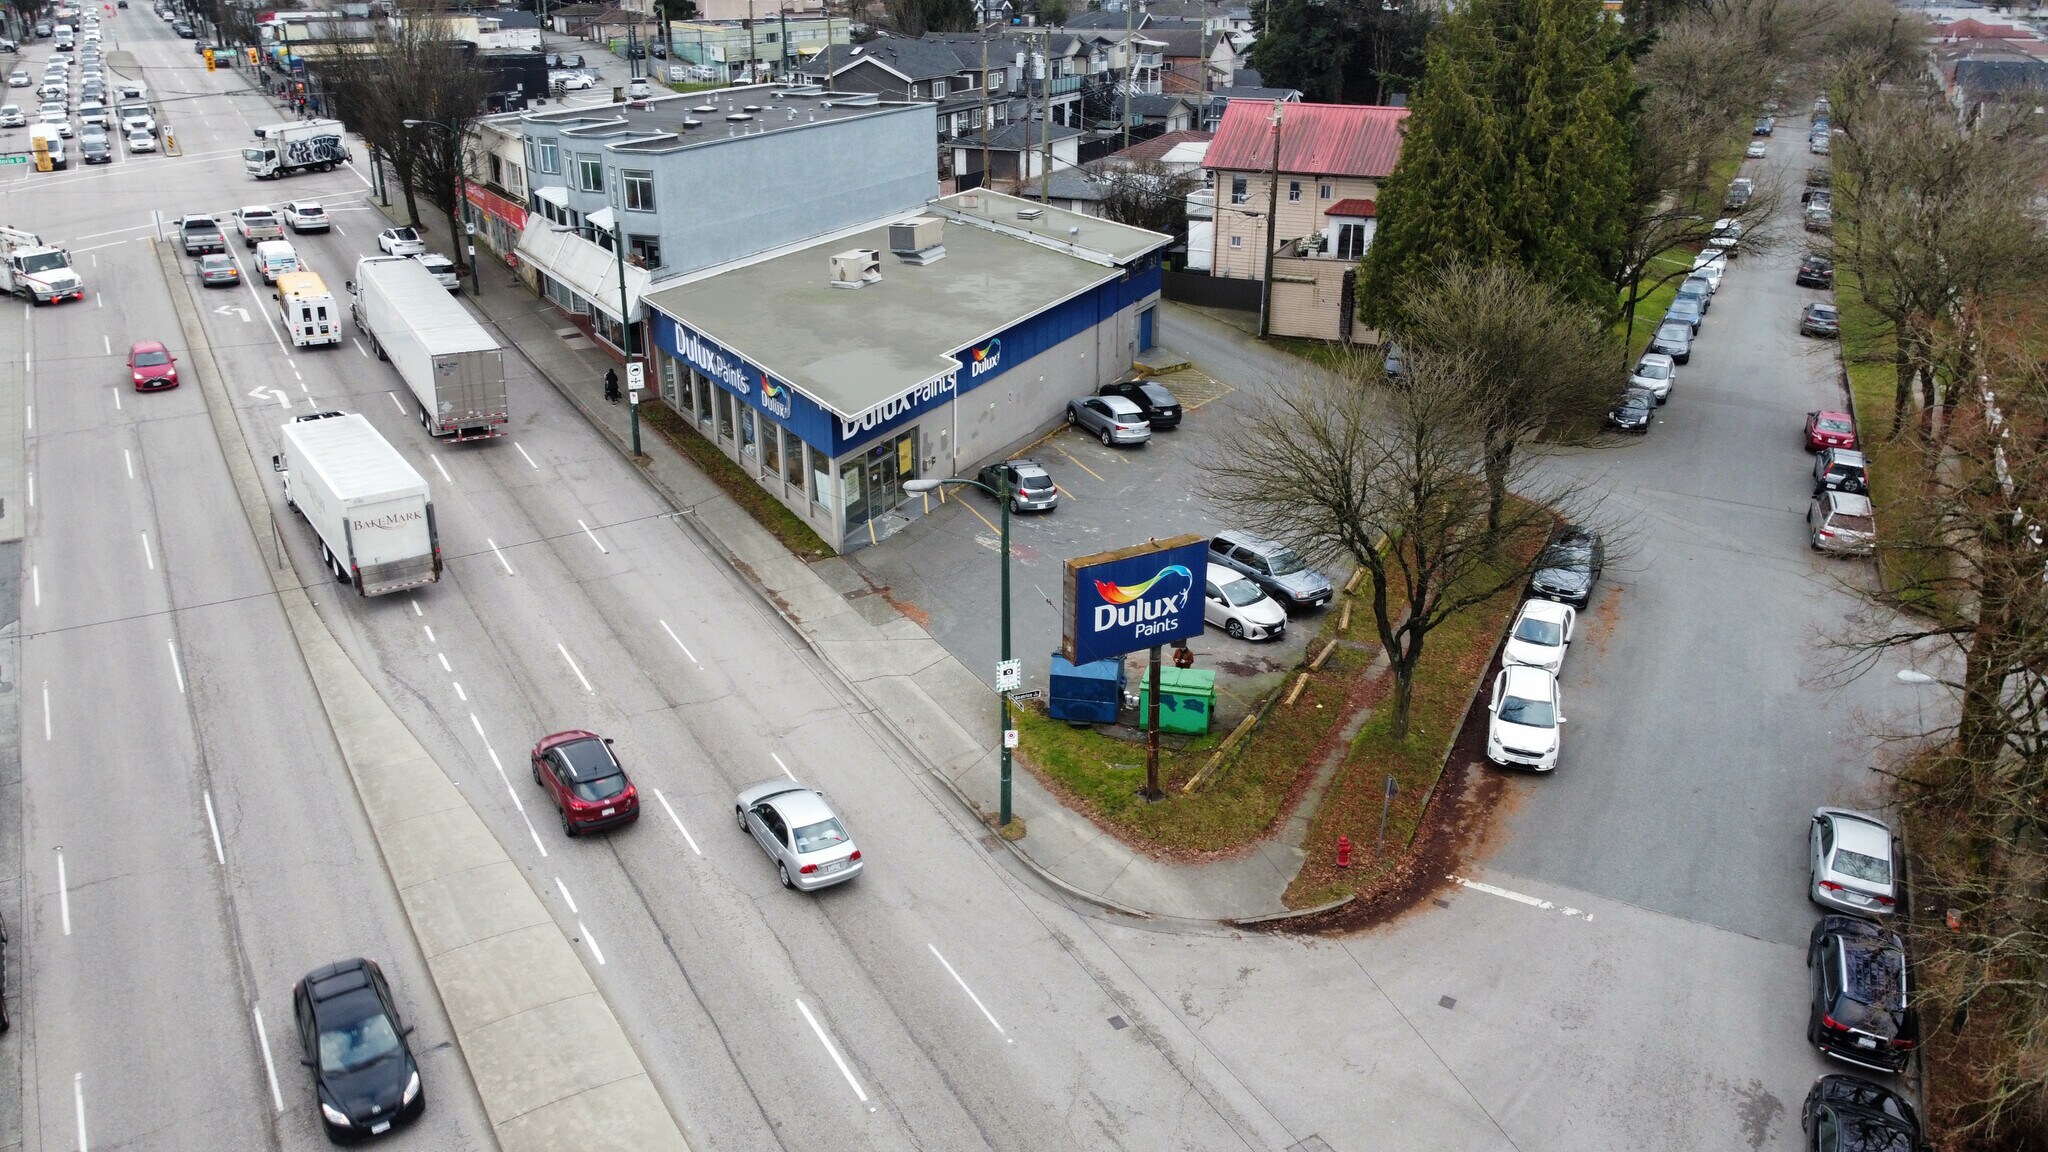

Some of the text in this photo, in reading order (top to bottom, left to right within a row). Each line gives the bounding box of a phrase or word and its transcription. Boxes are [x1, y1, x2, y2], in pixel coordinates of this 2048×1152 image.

[675, 323, 750, 394] Dulux Paints
[971, 356, 998, 377] Dulux
[761, 390, 786, 418] Dulux
[842, 372, 955, 440] Dulux Paints
[1094, 594, 1179, 632] Dulux
[1135, 618, 1179, 638] Paints
